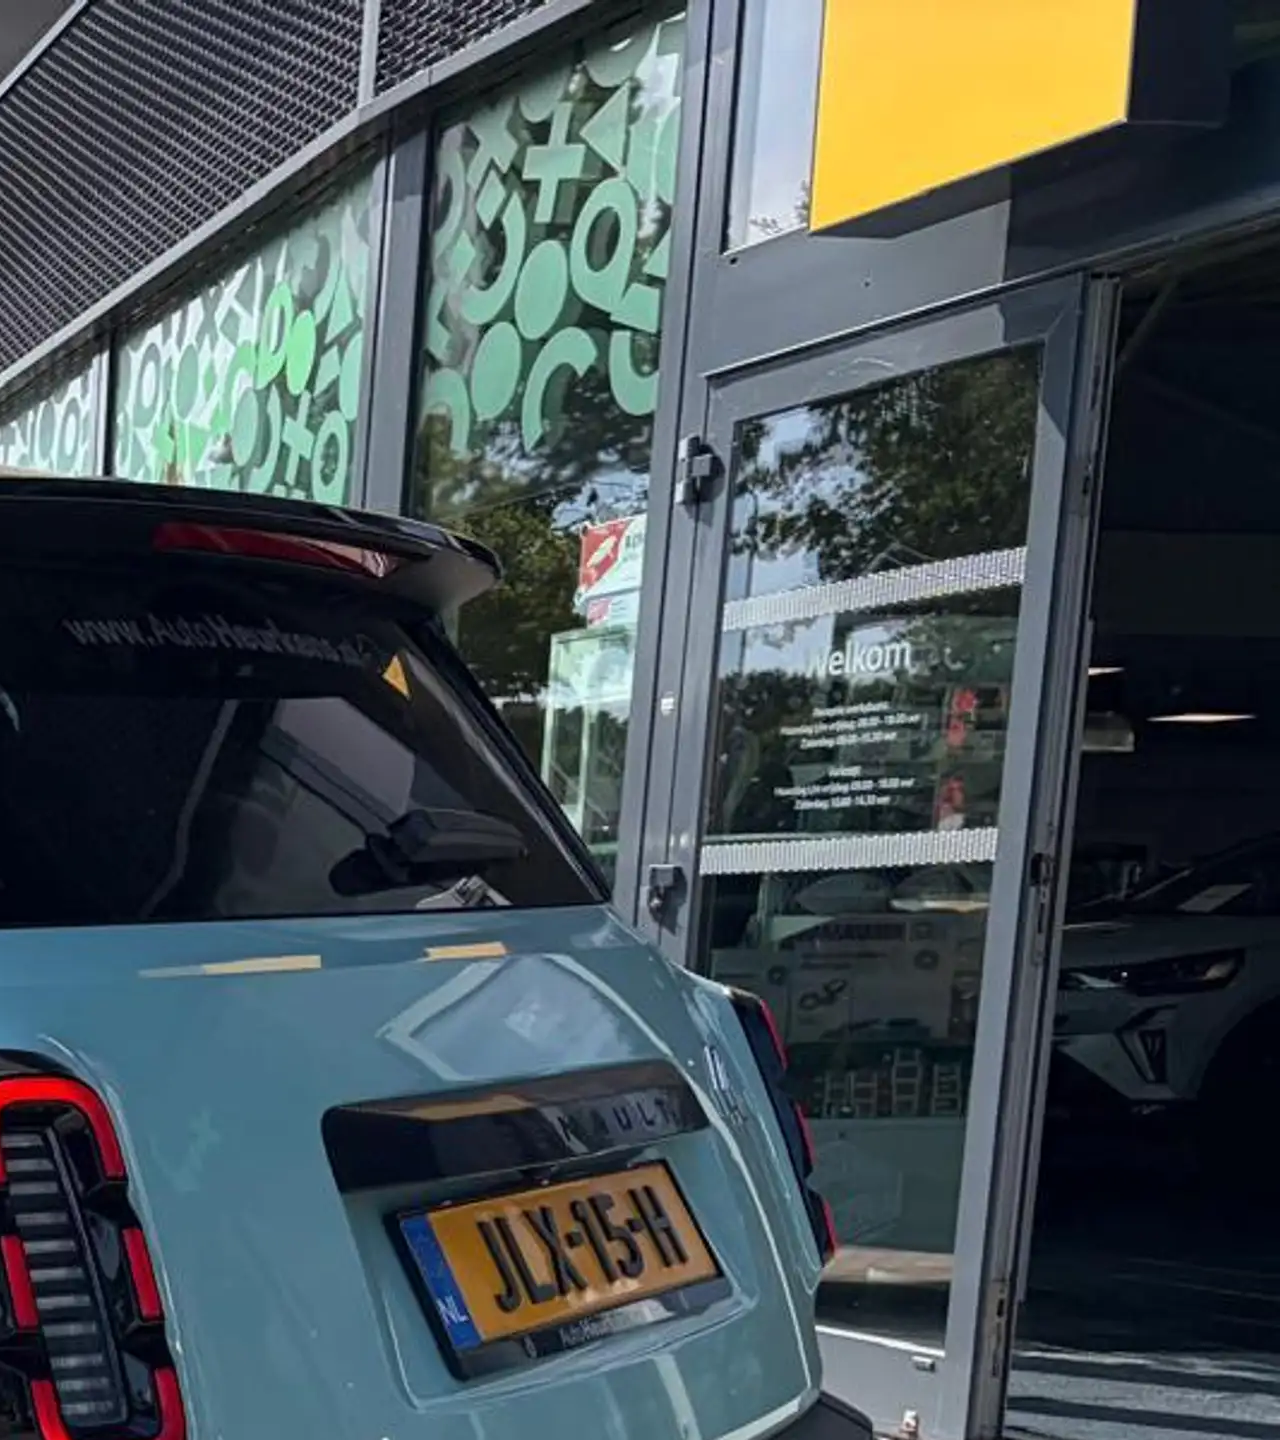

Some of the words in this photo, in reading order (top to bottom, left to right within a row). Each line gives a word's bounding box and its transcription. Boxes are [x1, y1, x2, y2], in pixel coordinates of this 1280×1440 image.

[806, 640, 911, 679] Welkom
[557, 1096, 670, 1141] NAULT
[476, 1185, 688, 1313] JLX-15-H
[438, 1296, 469, 1325] NL
